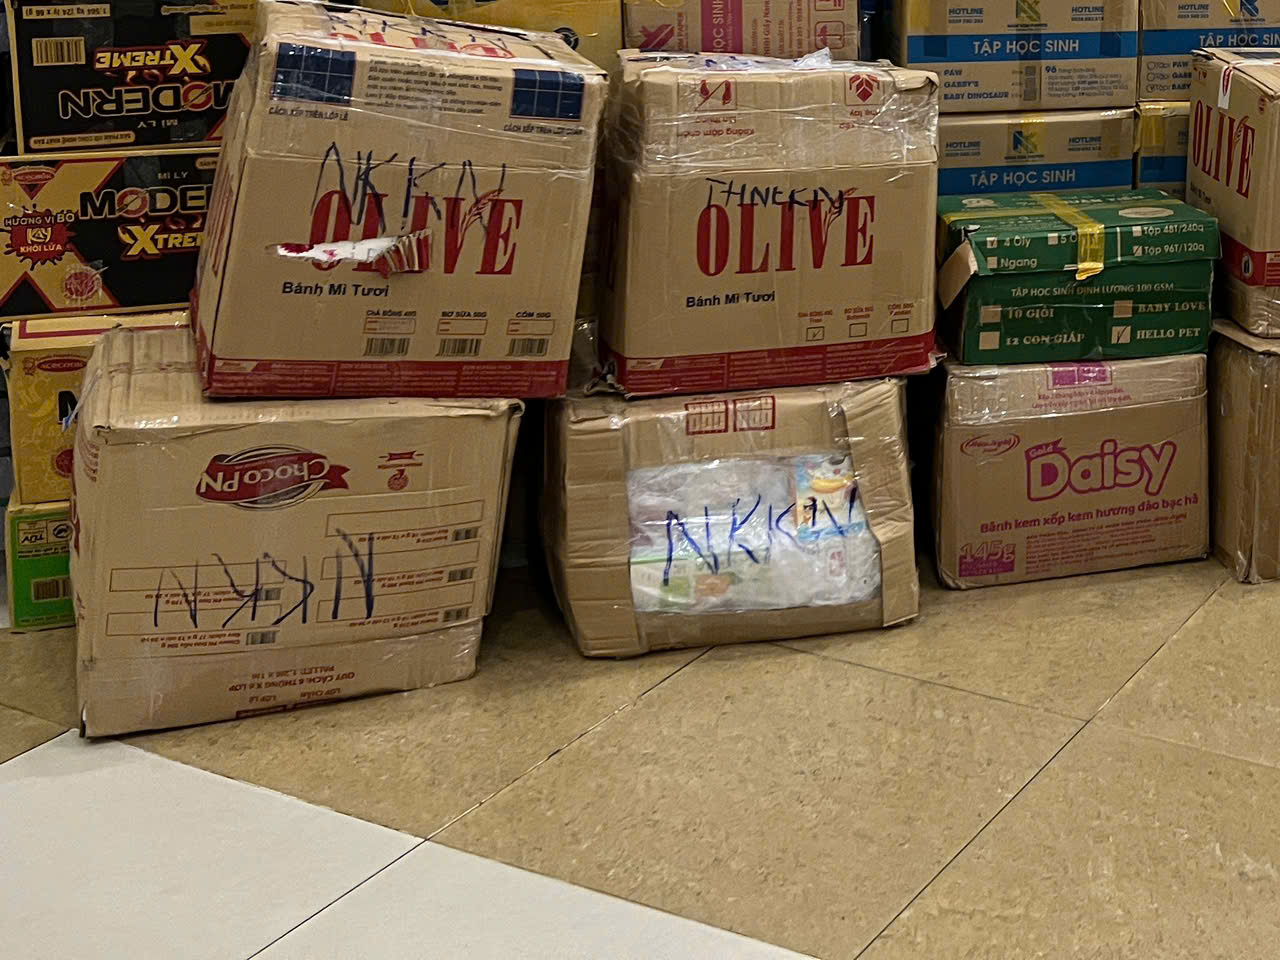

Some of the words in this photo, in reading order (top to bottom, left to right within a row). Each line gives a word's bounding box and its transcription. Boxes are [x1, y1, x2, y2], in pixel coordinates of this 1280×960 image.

[948, 7, 984, 16] HOTLINE
[1071, 6, 1104, 14] HOTLINE
[1178, 3, 1209, 11] HOTLINE
[973, 38, 1001, 56] TẬP
[1006, 40, 1041, 56] HỌC
[1045, 40, 1080, 53] SINH
[95, 43, 202, 75] XTREME
[59, 80, 237, 120] MODERN
[945, 141, 981, 150] HOTLINE
[1068, 136, 1102, 145] HOTLINE
[1192, 99, 1256, 199] OLIVE
[970, 170, 998, 188] TẬP
[1003, 171, 1037, 187] HỌC
[1042, 169, 1076, 184] SINH
[79, 187, 212, 220] MODE
[309, 189, 524, 276] OLIVE
[696, 190, 876, 277] OLIVE
[1000, 257, 1038, 270] Ngang
[281, 280, 322, 298] Bánh
[351, 282, 390, 298] Tươi
[686, 293, 721, 308] Bánh
[744, 290, 776, 304] Tươi
[1138, 302, 1172, 314] BABY
[1174, 300, 1206, 312] LOVE
[1136, 328, 1176, 340] HELLO
[1178, 326, 1201, 339] PET
[1025, 439, 1177, 502] Daisy
[980, 520, 1012, 534] Bánh
[1014, 517, 1041, 530] kem
[1042, 511, 1066, 528] xốp
[1068, 508, 1093, 523] kem
[1095, 502, 1136, 520] hương
